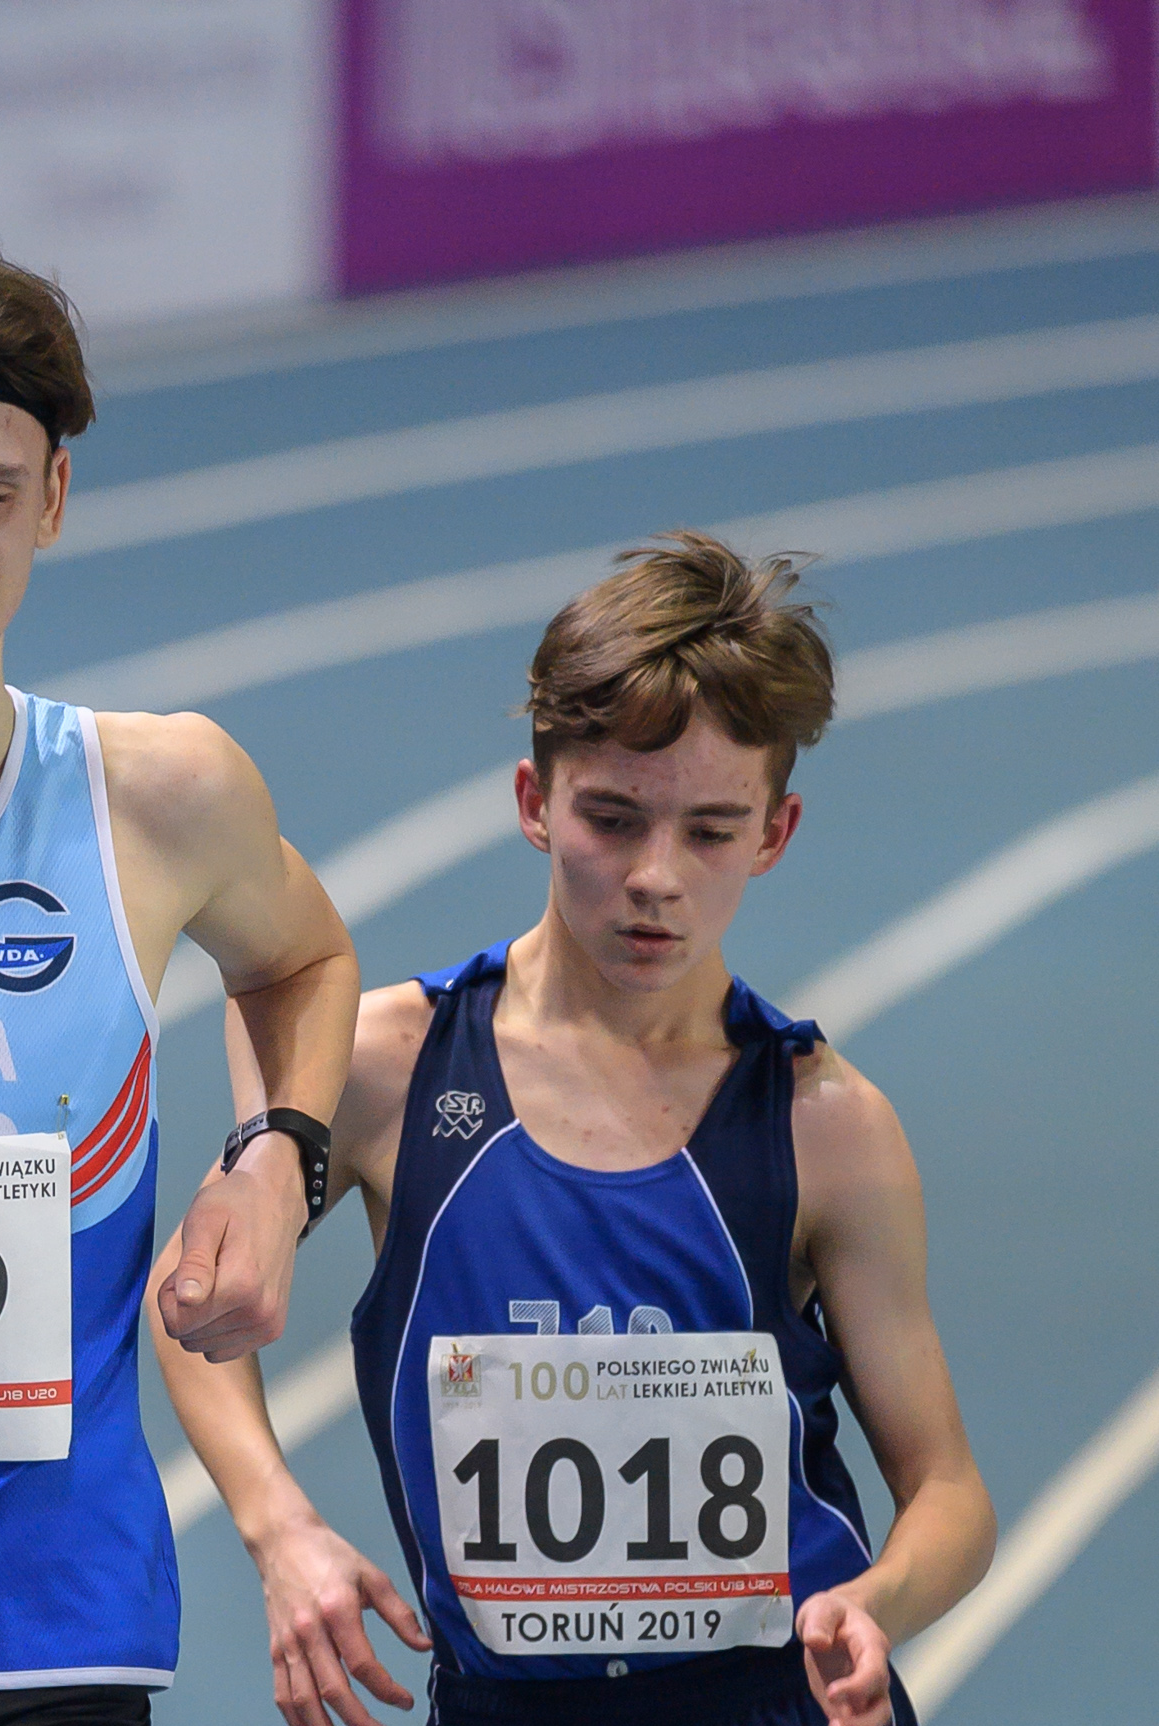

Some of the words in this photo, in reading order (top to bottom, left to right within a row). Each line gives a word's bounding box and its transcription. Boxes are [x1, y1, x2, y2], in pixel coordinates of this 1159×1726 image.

[27, 1387, 58, 1400] U20
[507, 1361, 590, 1401] 100
[596, 1359, 696, 1377] POLSKIEGO
[700, 1358, 770, 1377] ZWIĄZKU
[596, 1384, 628, 1401] LAT
[633, 1383, 699, 1399] LEKKIEJ
[703, 1380, 774, 1398] ATLETYKI
[452, 1433, 769, 1564] 1018
[485, 1582, 546, 1596] HALOWE
[548, 1582, 662, 1595] MISTRZOSTWA
[664, 1581, 718, 1594] POLSKI
[720, 1580, 746, 1593] U18
[748, 1578, 775, 1591] U20
[501, 1602, 624, 1643] TORUŃ
[637, 1609, 722, 1641] 2019
